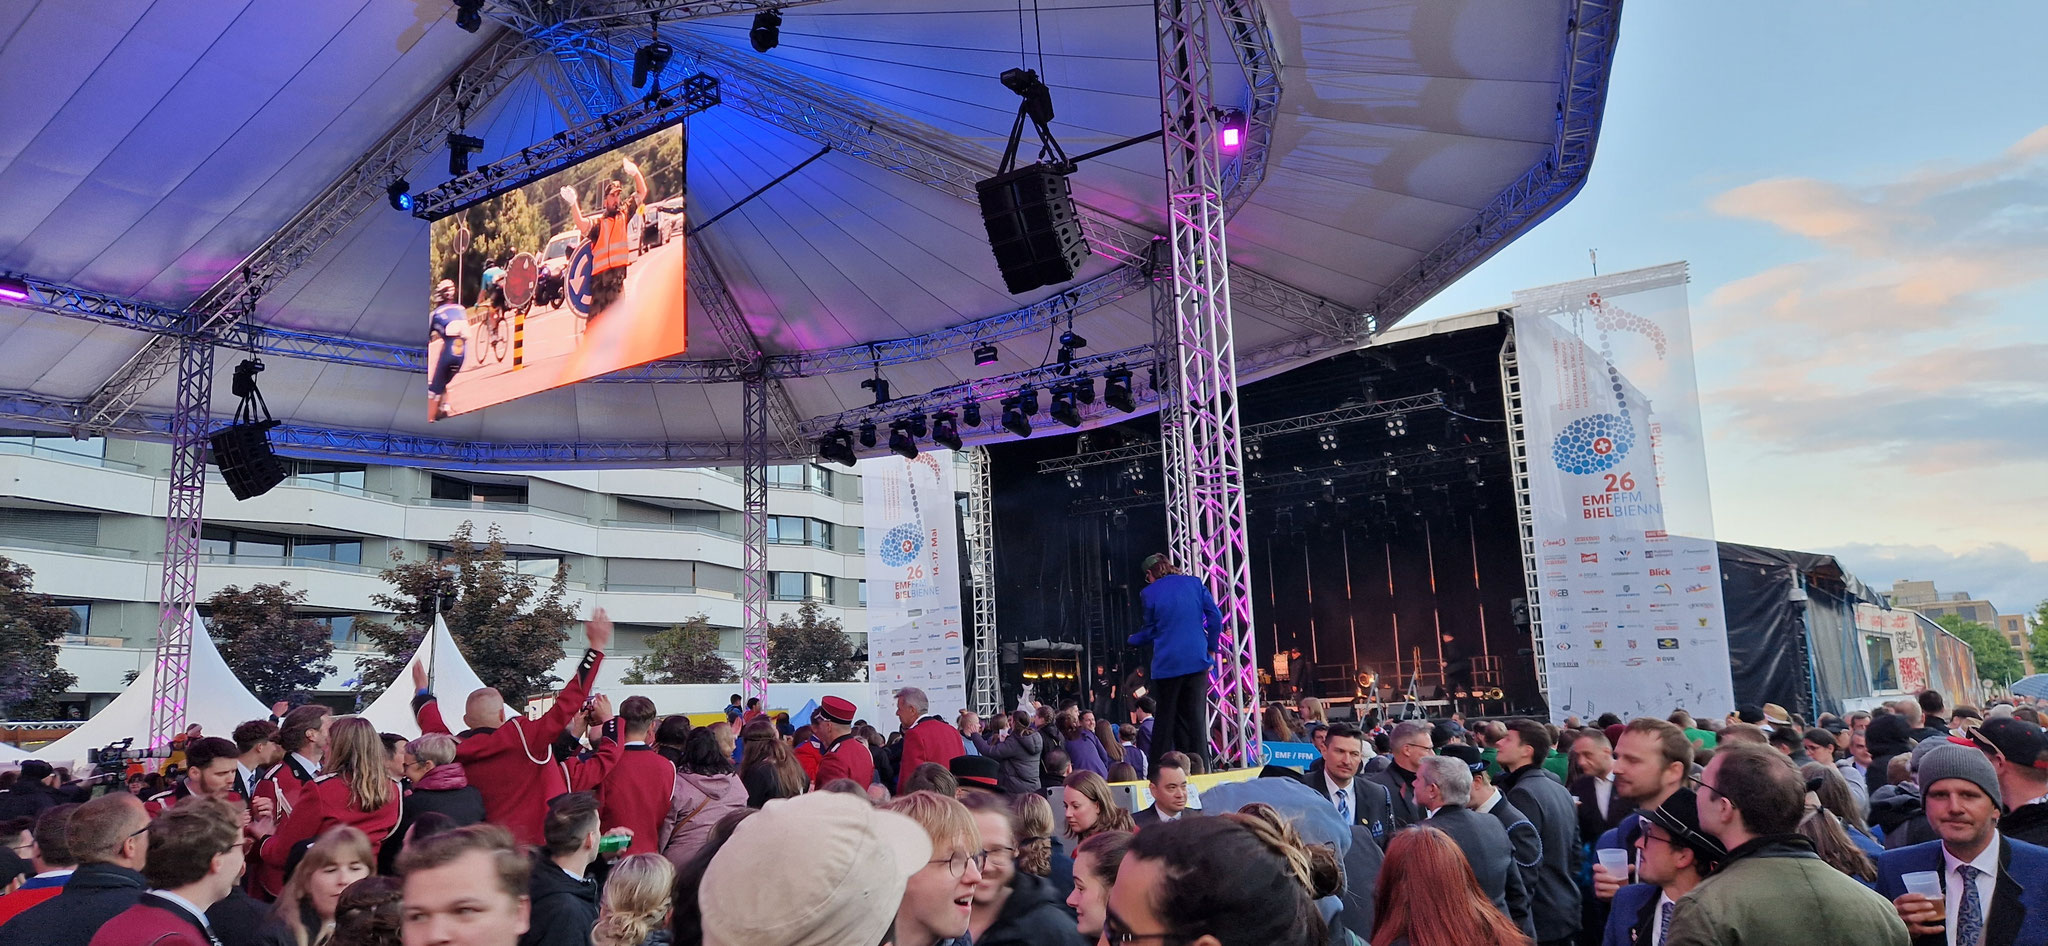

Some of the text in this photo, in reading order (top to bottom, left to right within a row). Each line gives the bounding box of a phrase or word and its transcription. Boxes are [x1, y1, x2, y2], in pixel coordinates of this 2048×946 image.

[1648, 422, 1663, 448] Mai
[1603, 471, 1636, 493] 26
[1583, 502, 1665, 519] BIELBIENN
[930, 528, 938, 547] Mai
[906, 564, 923, 580] 26
[1649, 568, 1671, 576] Blick
[1275, 751, 1291, 759] EMF
[1298, 752, 1313, 760] FFM
